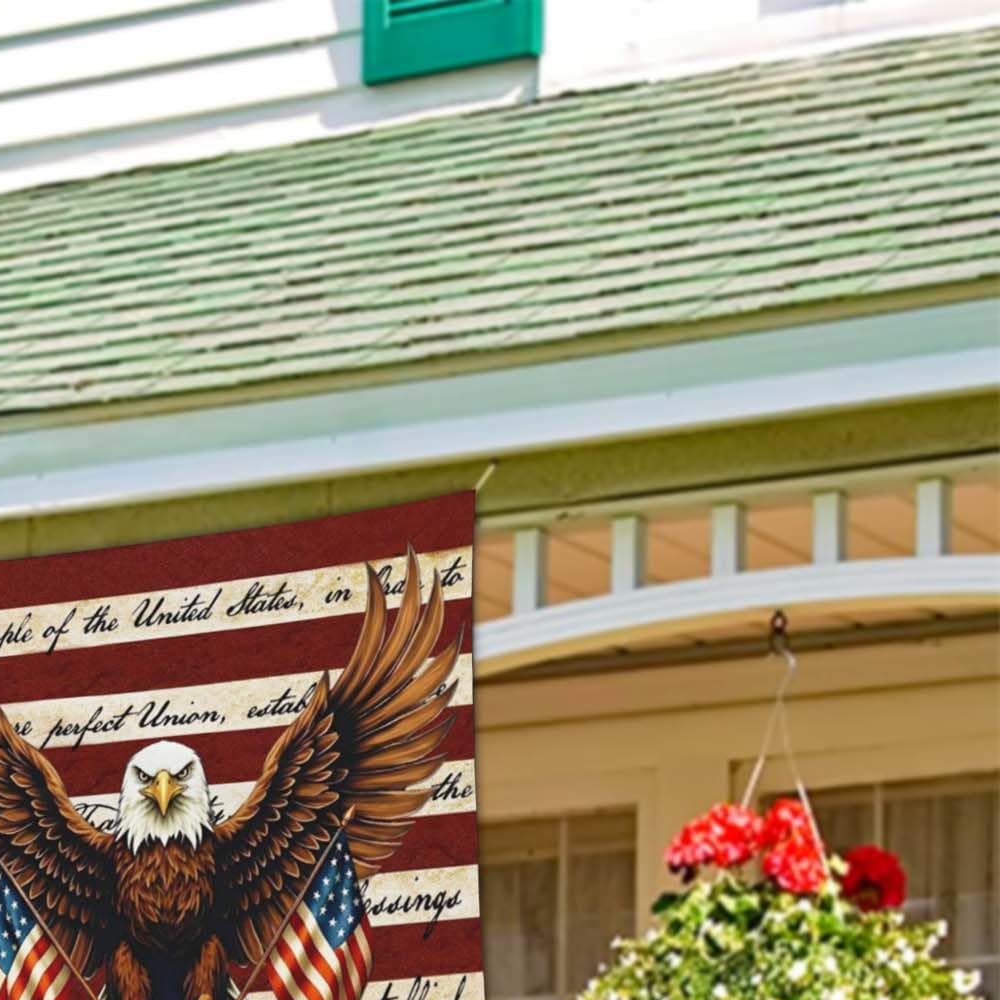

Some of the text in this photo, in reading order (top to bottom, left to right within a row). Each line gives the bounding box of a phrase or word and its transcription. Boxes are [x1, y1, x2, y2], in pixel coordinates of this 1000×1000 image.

[43, 607, 78, 656] of
[83, 604, 120, 634] the
[133, 588, 222, 627] United
[226, 581, 305, 616] States,
[325, 577, 353, 603] in
[440, 556, 467, 587] to
[40, 705, 134, 750] perfect
[139, 700, 226, 728] Union,
[247, 682, 317, 719] estab
[430, 772, 474, 800] the
